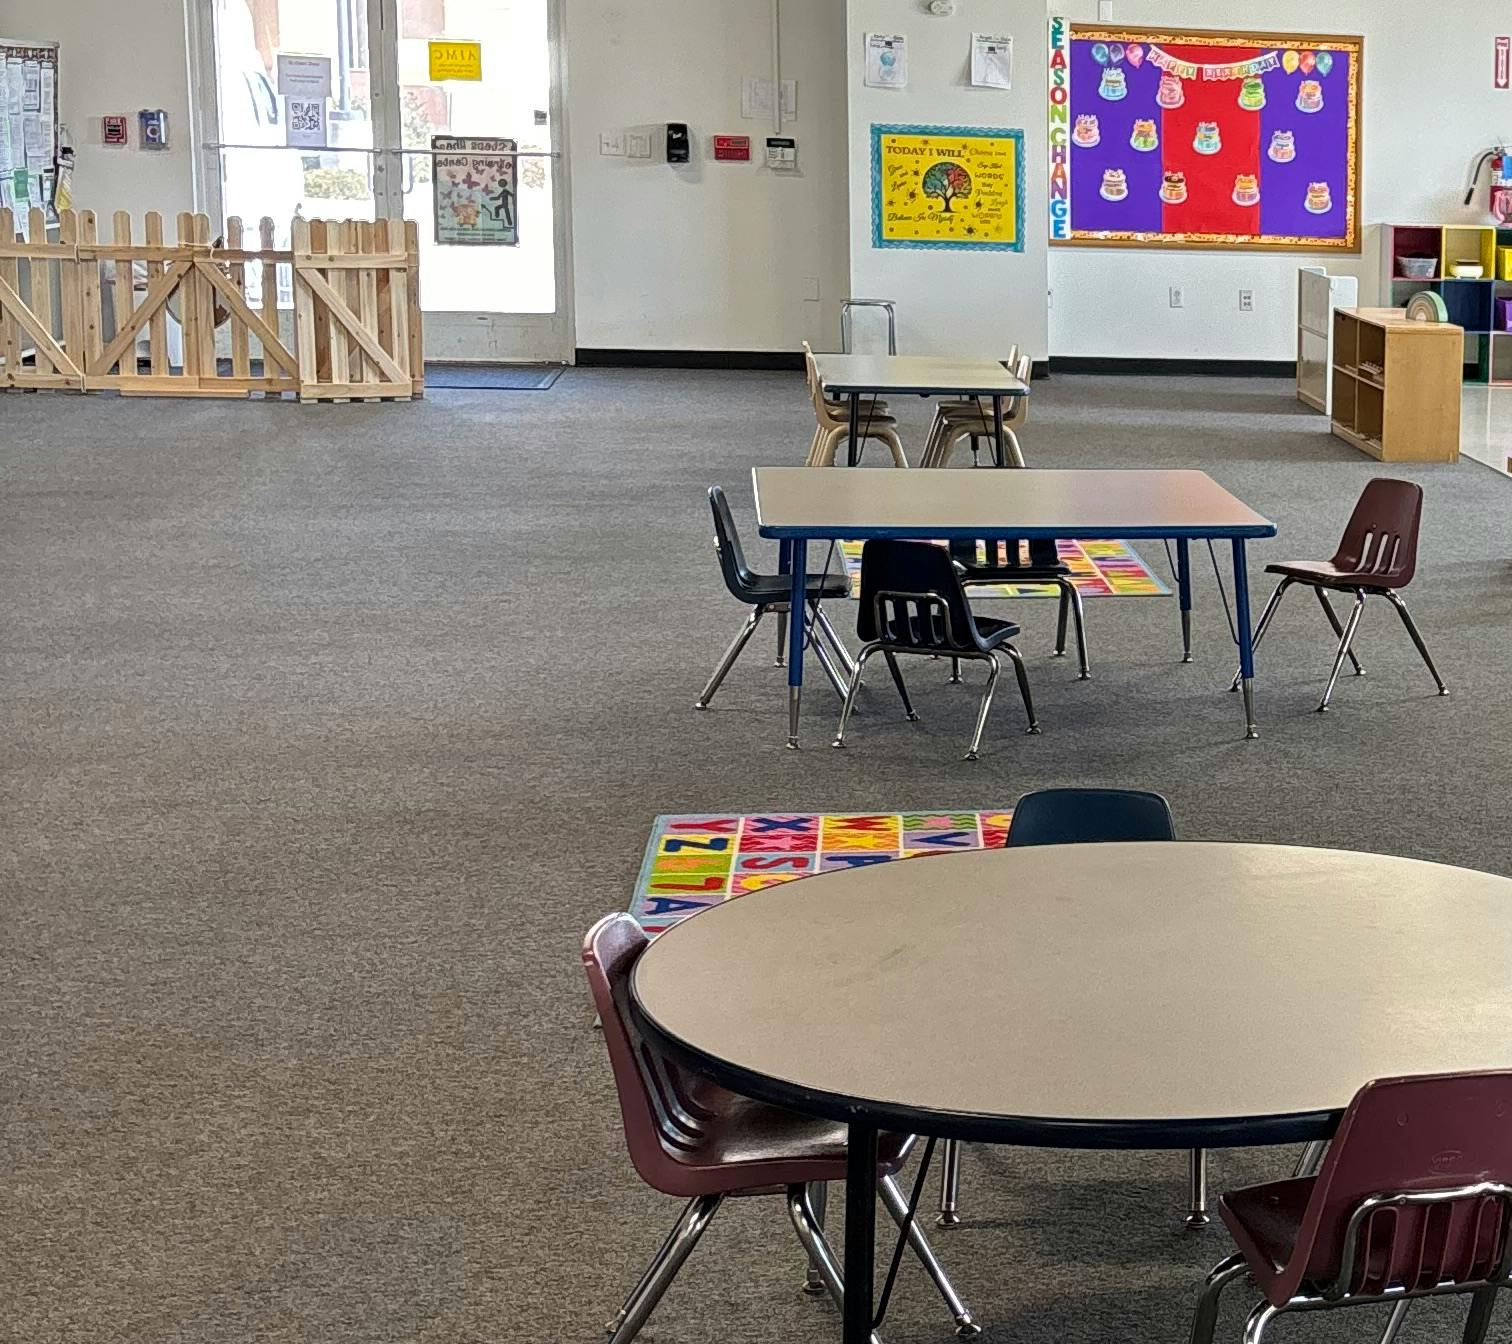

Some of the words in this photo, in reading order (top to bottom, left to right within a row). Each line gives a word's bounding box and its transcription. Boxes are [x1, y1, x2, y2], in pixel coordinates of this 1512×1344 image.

[1050, 16, 1067, 123] SEASON
[886, 145, 927, 156] TODAY
[929, 147, 933, 156] I
[1050, 127, 1067, 238] CHANGE
